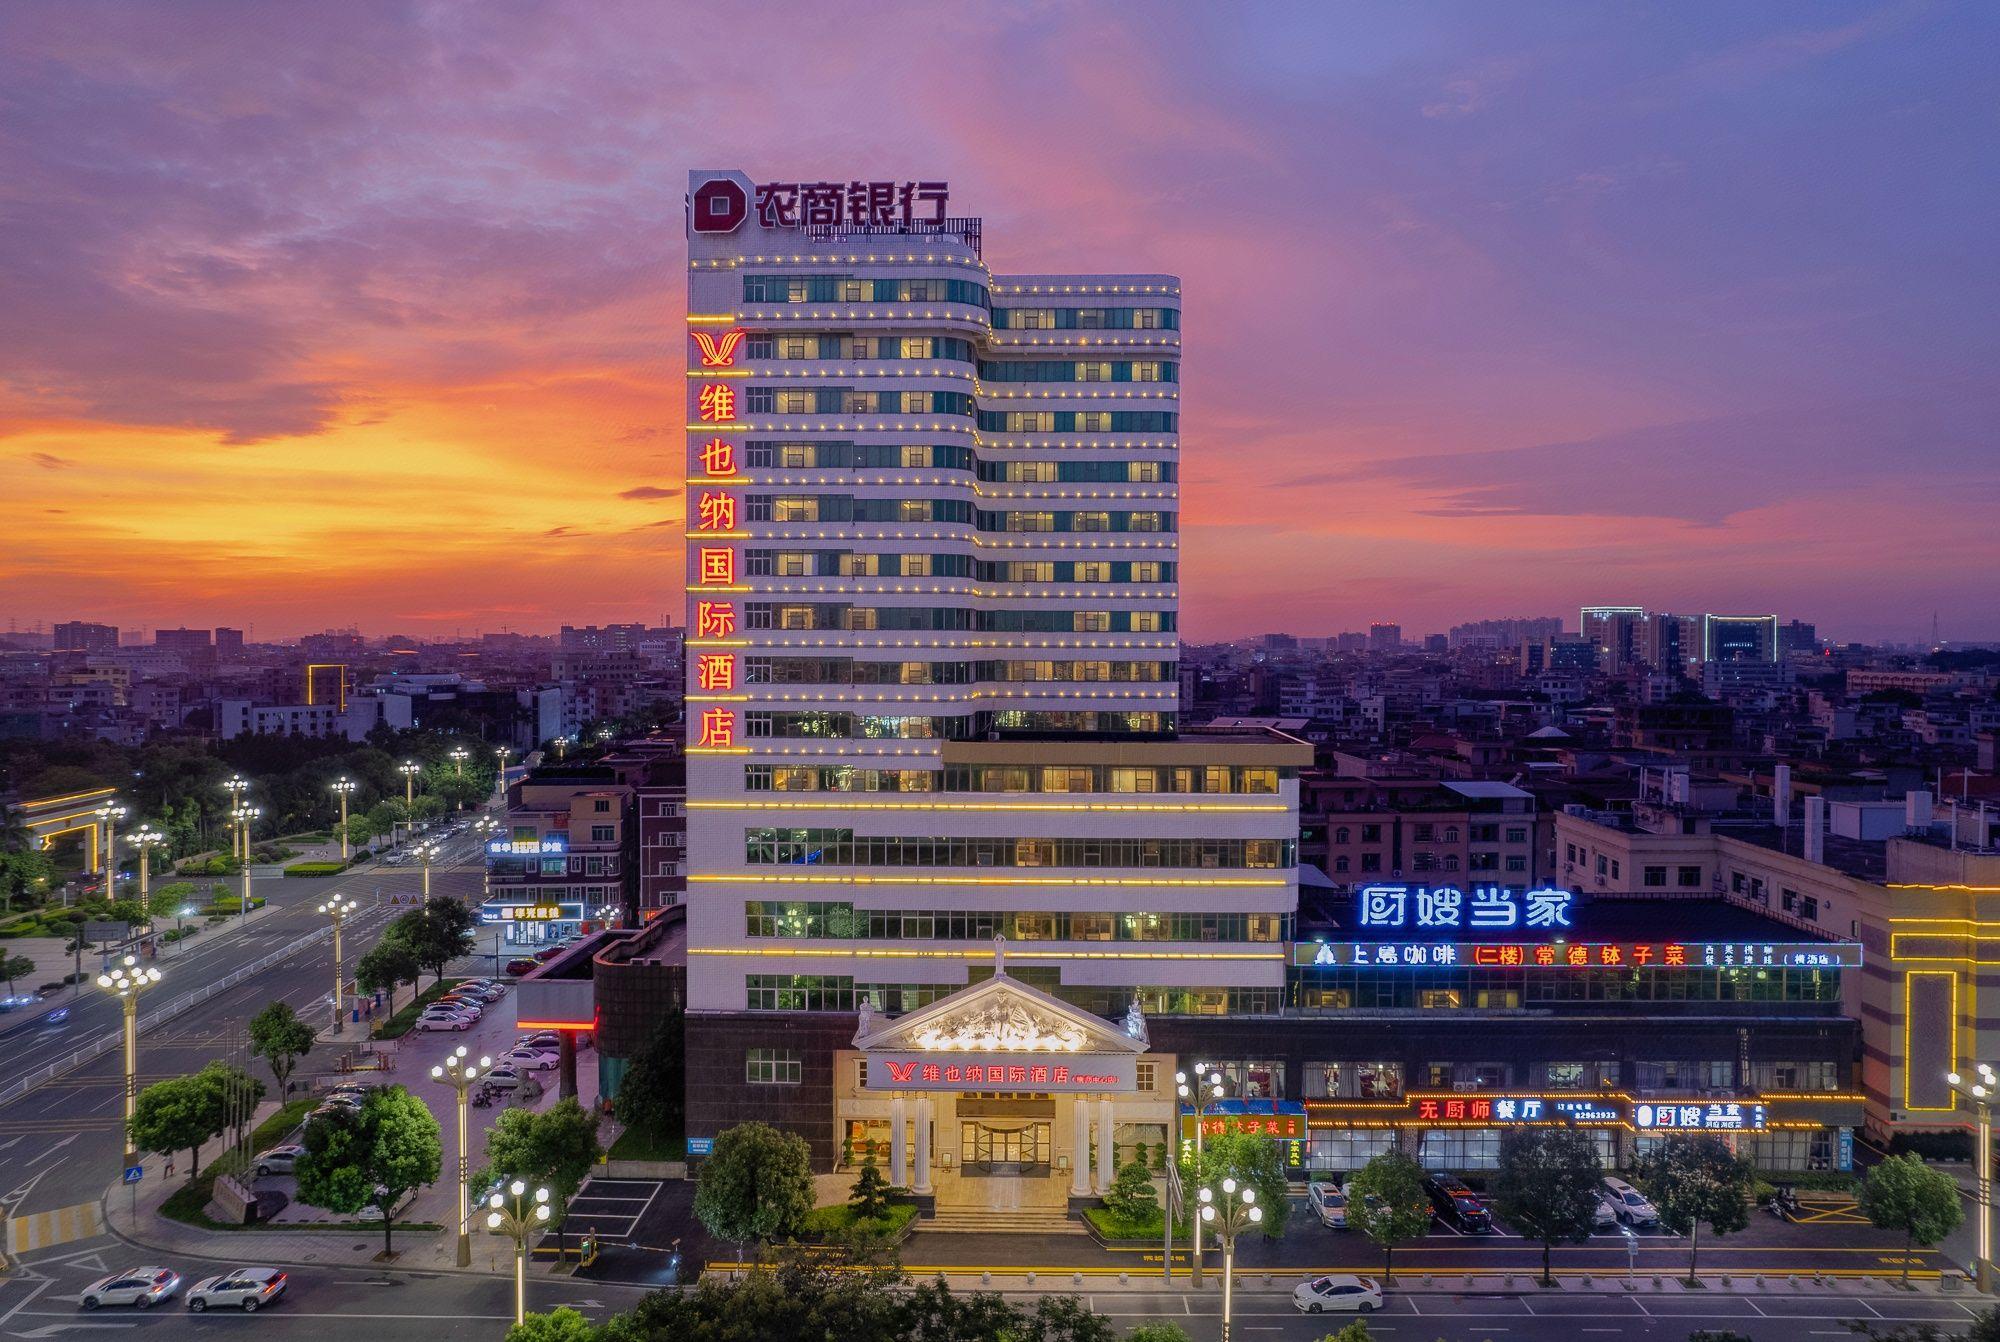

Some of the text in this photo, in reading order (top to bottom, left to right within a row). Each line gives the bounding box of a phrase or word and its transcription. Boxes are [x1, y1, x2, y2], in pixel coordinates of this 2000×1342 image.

[755, 181, 949, 229] 农商银行
[698, 384, 736, 747] 维也纳国际酒店
[1361, 887, 1572, 927] 厨嫂当家
[922, 1065, 1069, 1083] 维也纳国际酒店
